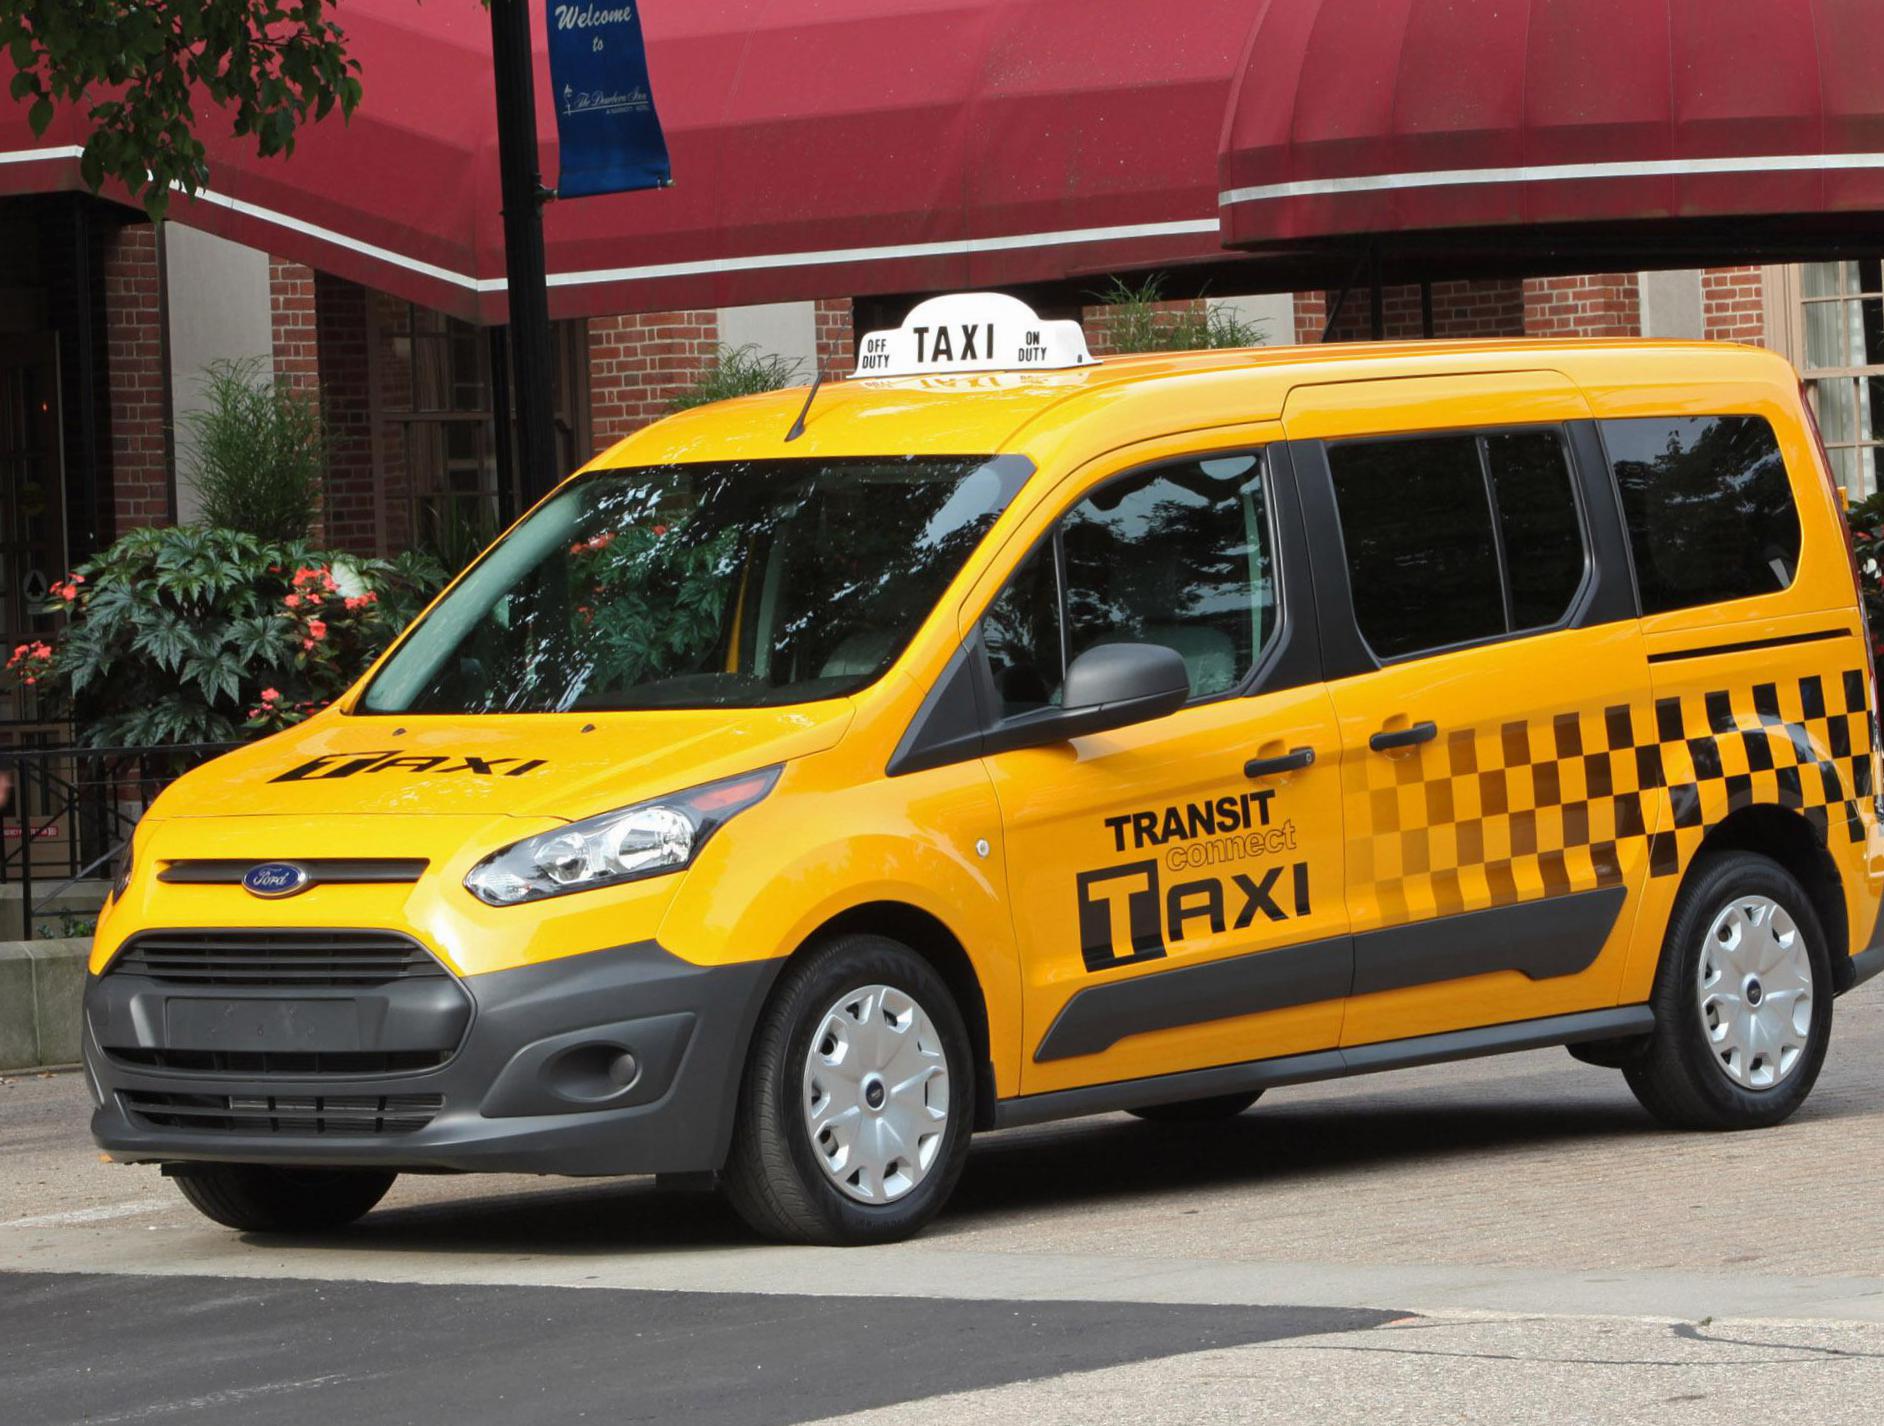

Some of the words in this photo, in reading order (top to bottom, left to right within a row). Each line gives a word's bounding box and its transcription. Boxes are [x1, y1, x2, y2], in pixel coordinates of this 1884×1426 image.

[554, 3, 632, 30] Welcome
[592, 36, 604, 52] to
[867, 338, 887, 353] OFF
[913, 323, 994, 363] TAXI
[1025, 331, 1040, 346] ON
[862, 354, 890, 369] DUTY
[1018, 346, 1047, 362] DUTY
[266, 750, 549, 784] TAXI
[1104, 789, 1276, 852] TRANSIT
[1165, 817, 1297, 872] connect
[252, 870, 290, 886] Ford
[1076, 858, 1311, 973] TAXI
